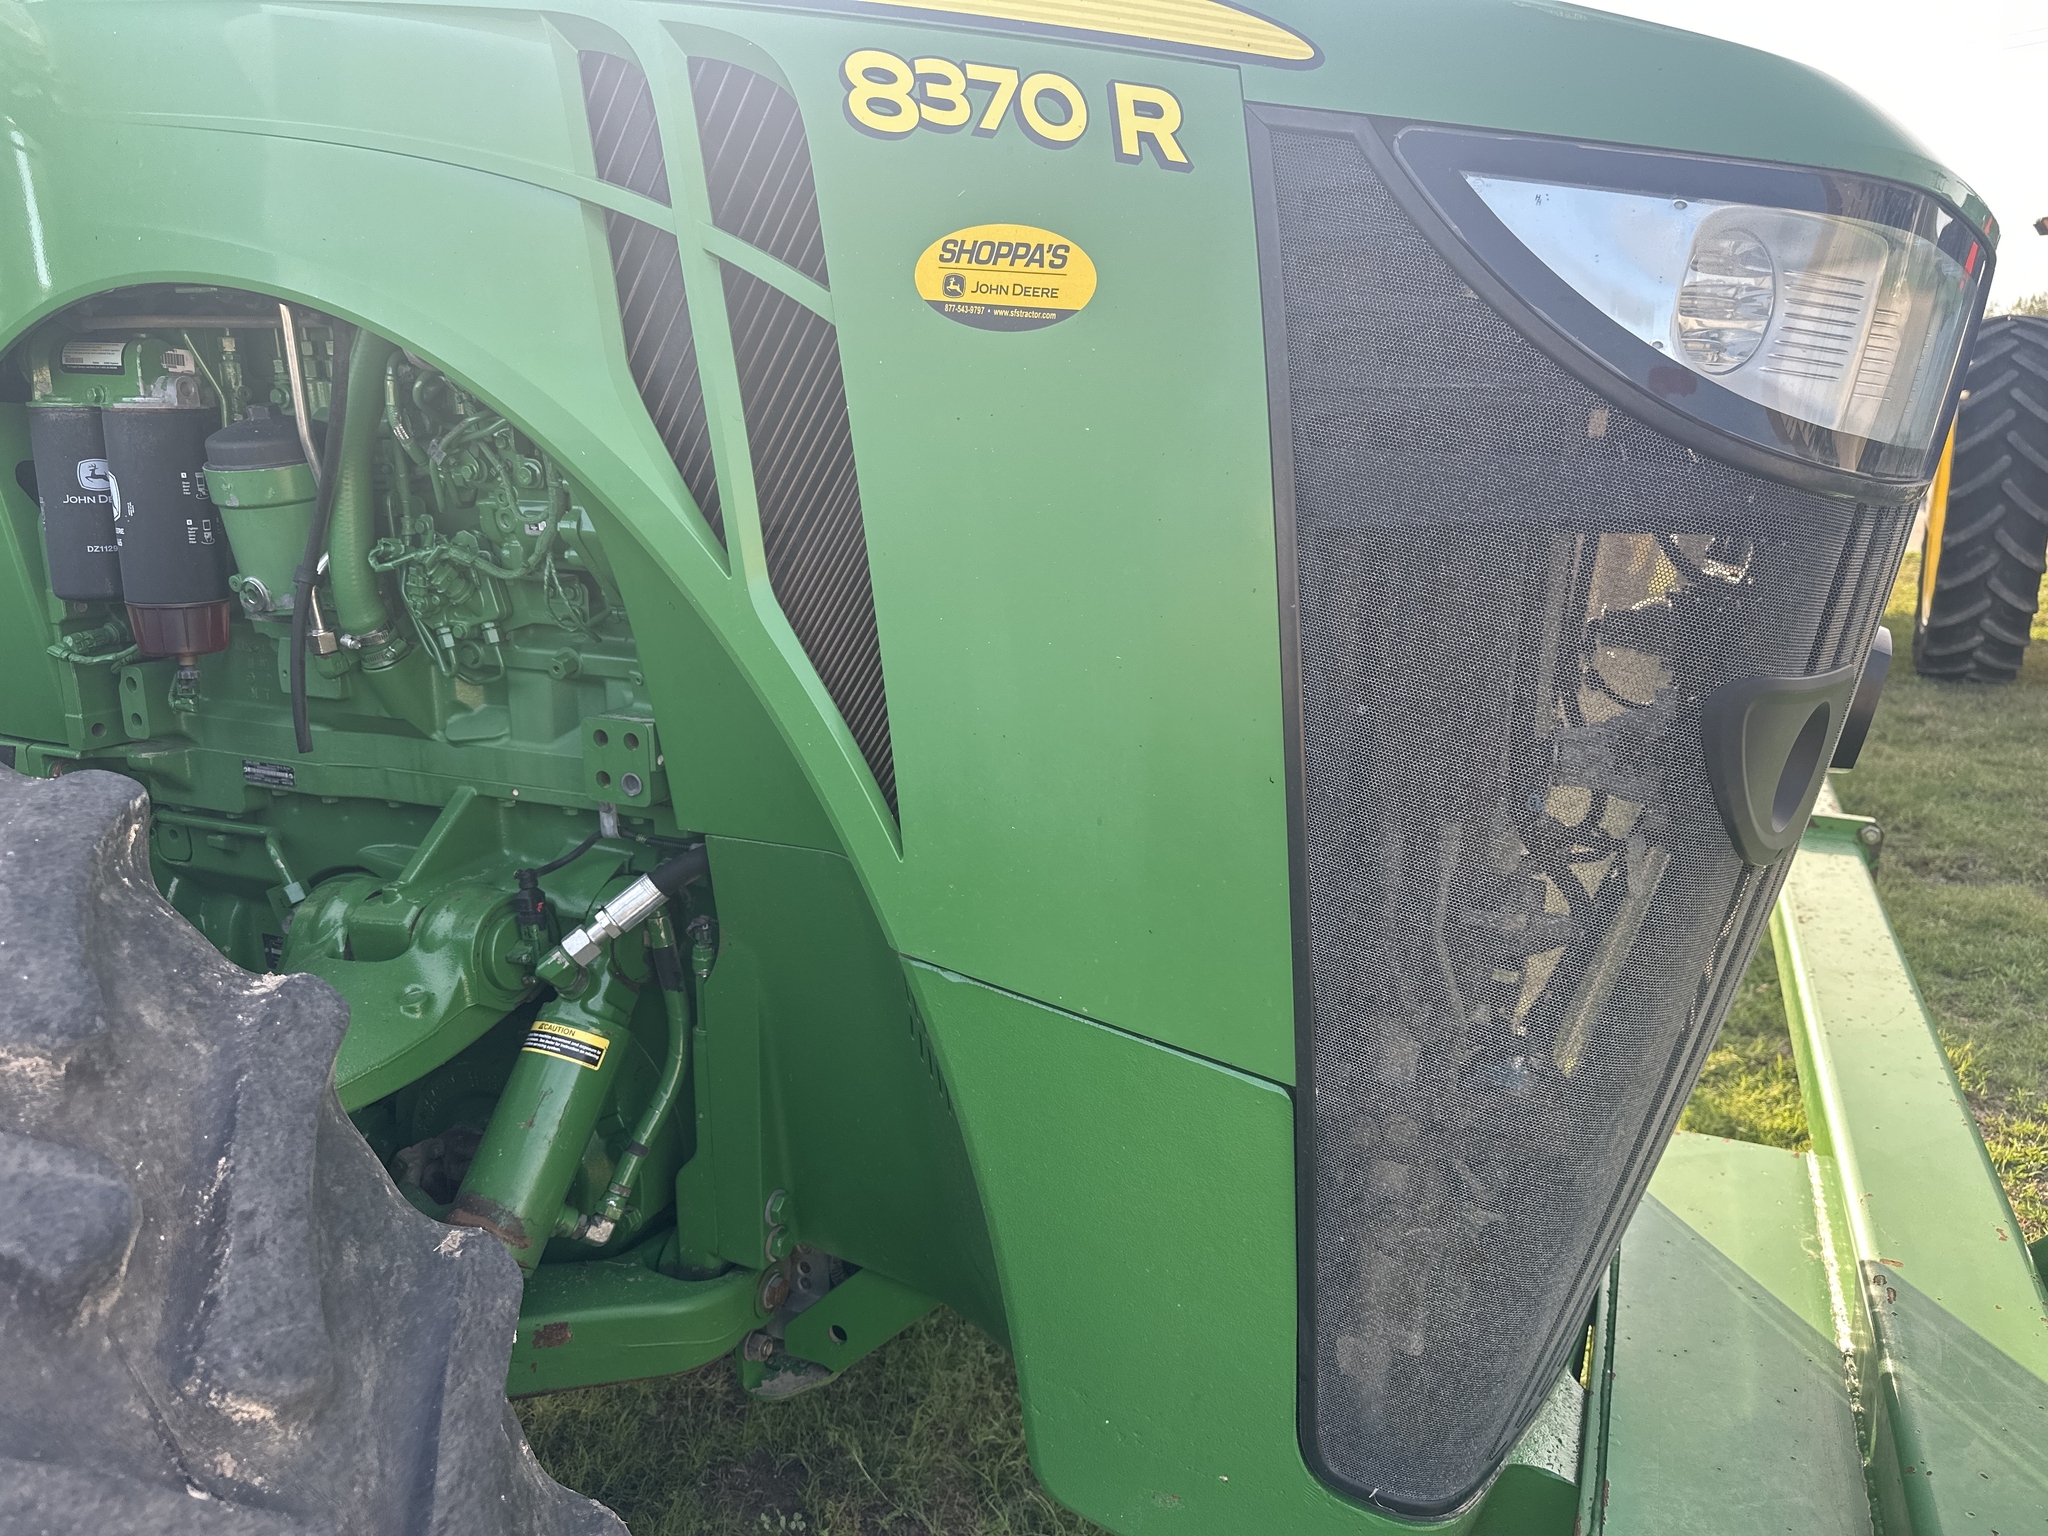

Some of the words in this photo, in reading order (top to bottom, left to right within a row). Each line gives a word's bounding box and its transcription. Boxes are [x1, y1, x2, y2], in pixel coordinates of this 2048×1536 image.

[841, 47, 1090, 148] 8370
[1108, 80, 1193, 171] R
[939, 239, 1070, 269] SHOPPA'S
[971, 281, 1009, 296] JOHN
[1012, 283, 1059, 299] DEERE
[944, 303, 985, 315] 877-543-9797
[993, 308, 1057, 320] www.sfstractor.com
[63, 494, 96, 504] JOHN
[87, 544, 119, 553] DZ1129
[543, 1023, 576, 1037] CAUTION
